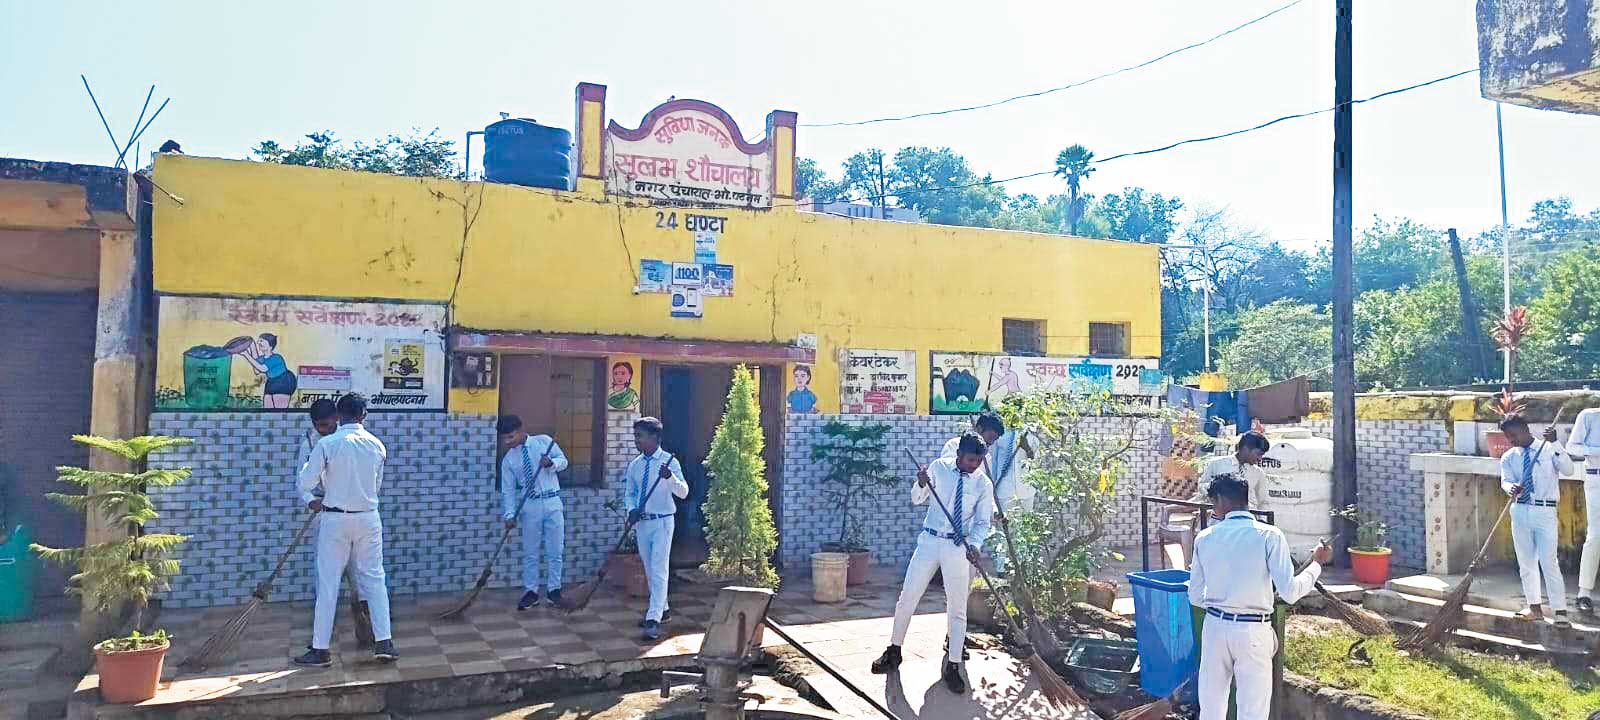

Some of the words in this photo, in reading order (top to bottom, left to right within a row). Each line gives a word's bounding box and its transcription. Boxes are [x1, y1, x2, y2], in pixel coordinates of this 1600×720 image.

[685, 154, 764, 188] शौचालय
[634, 180, 670, 198] नगर
[655, 211, 679, 230] 24
[1256, 458, 1281, 469] ECTUS
